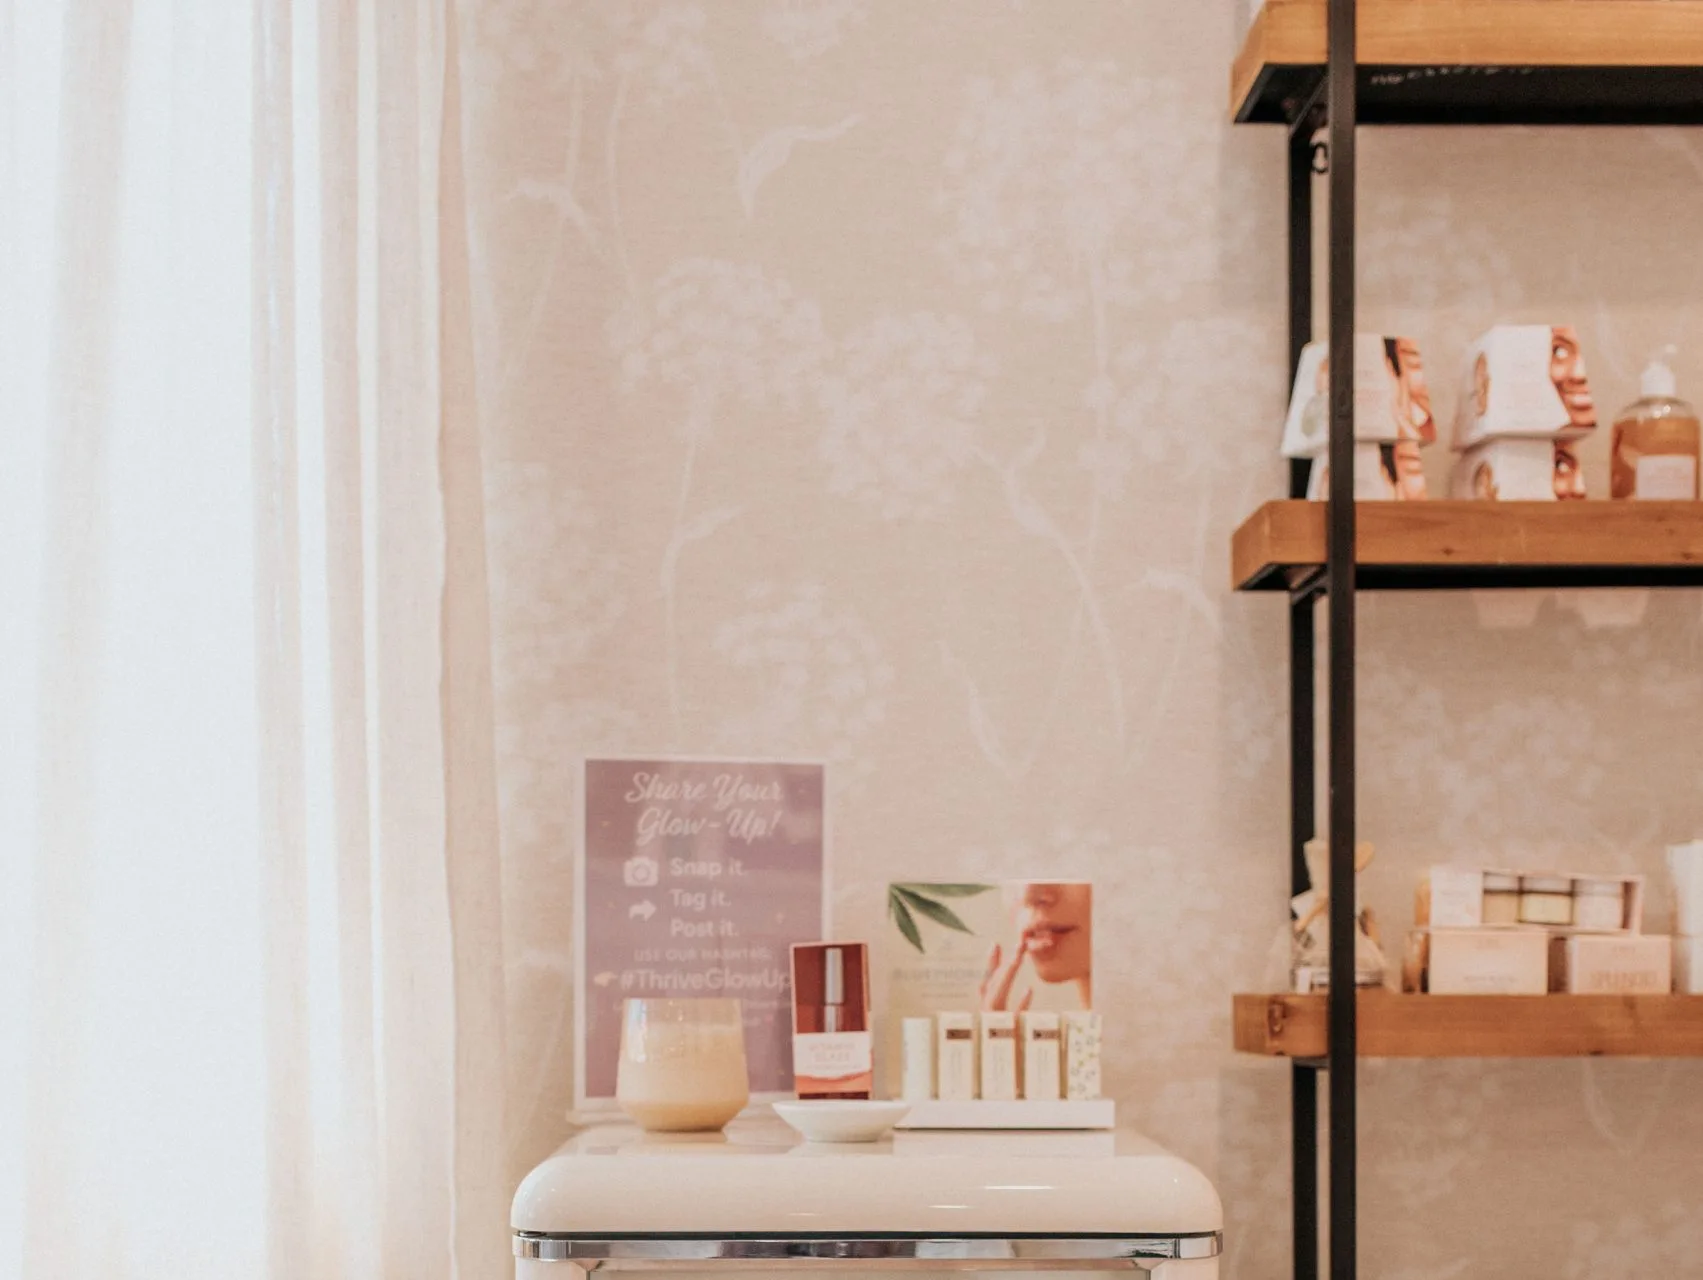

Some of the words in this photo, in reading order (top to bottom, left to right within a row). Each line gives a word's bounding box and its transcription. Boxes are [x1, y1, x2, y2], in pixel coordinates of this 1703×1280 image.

[624, 771, 707, 804] Share
[712, 773, 784, 812] Your
[669, 857, 722, 880] Snap
[669, 888, 706, 912] Tag
[670, 917, 714, 938] Post
[719, 917, 740, 938] it.
